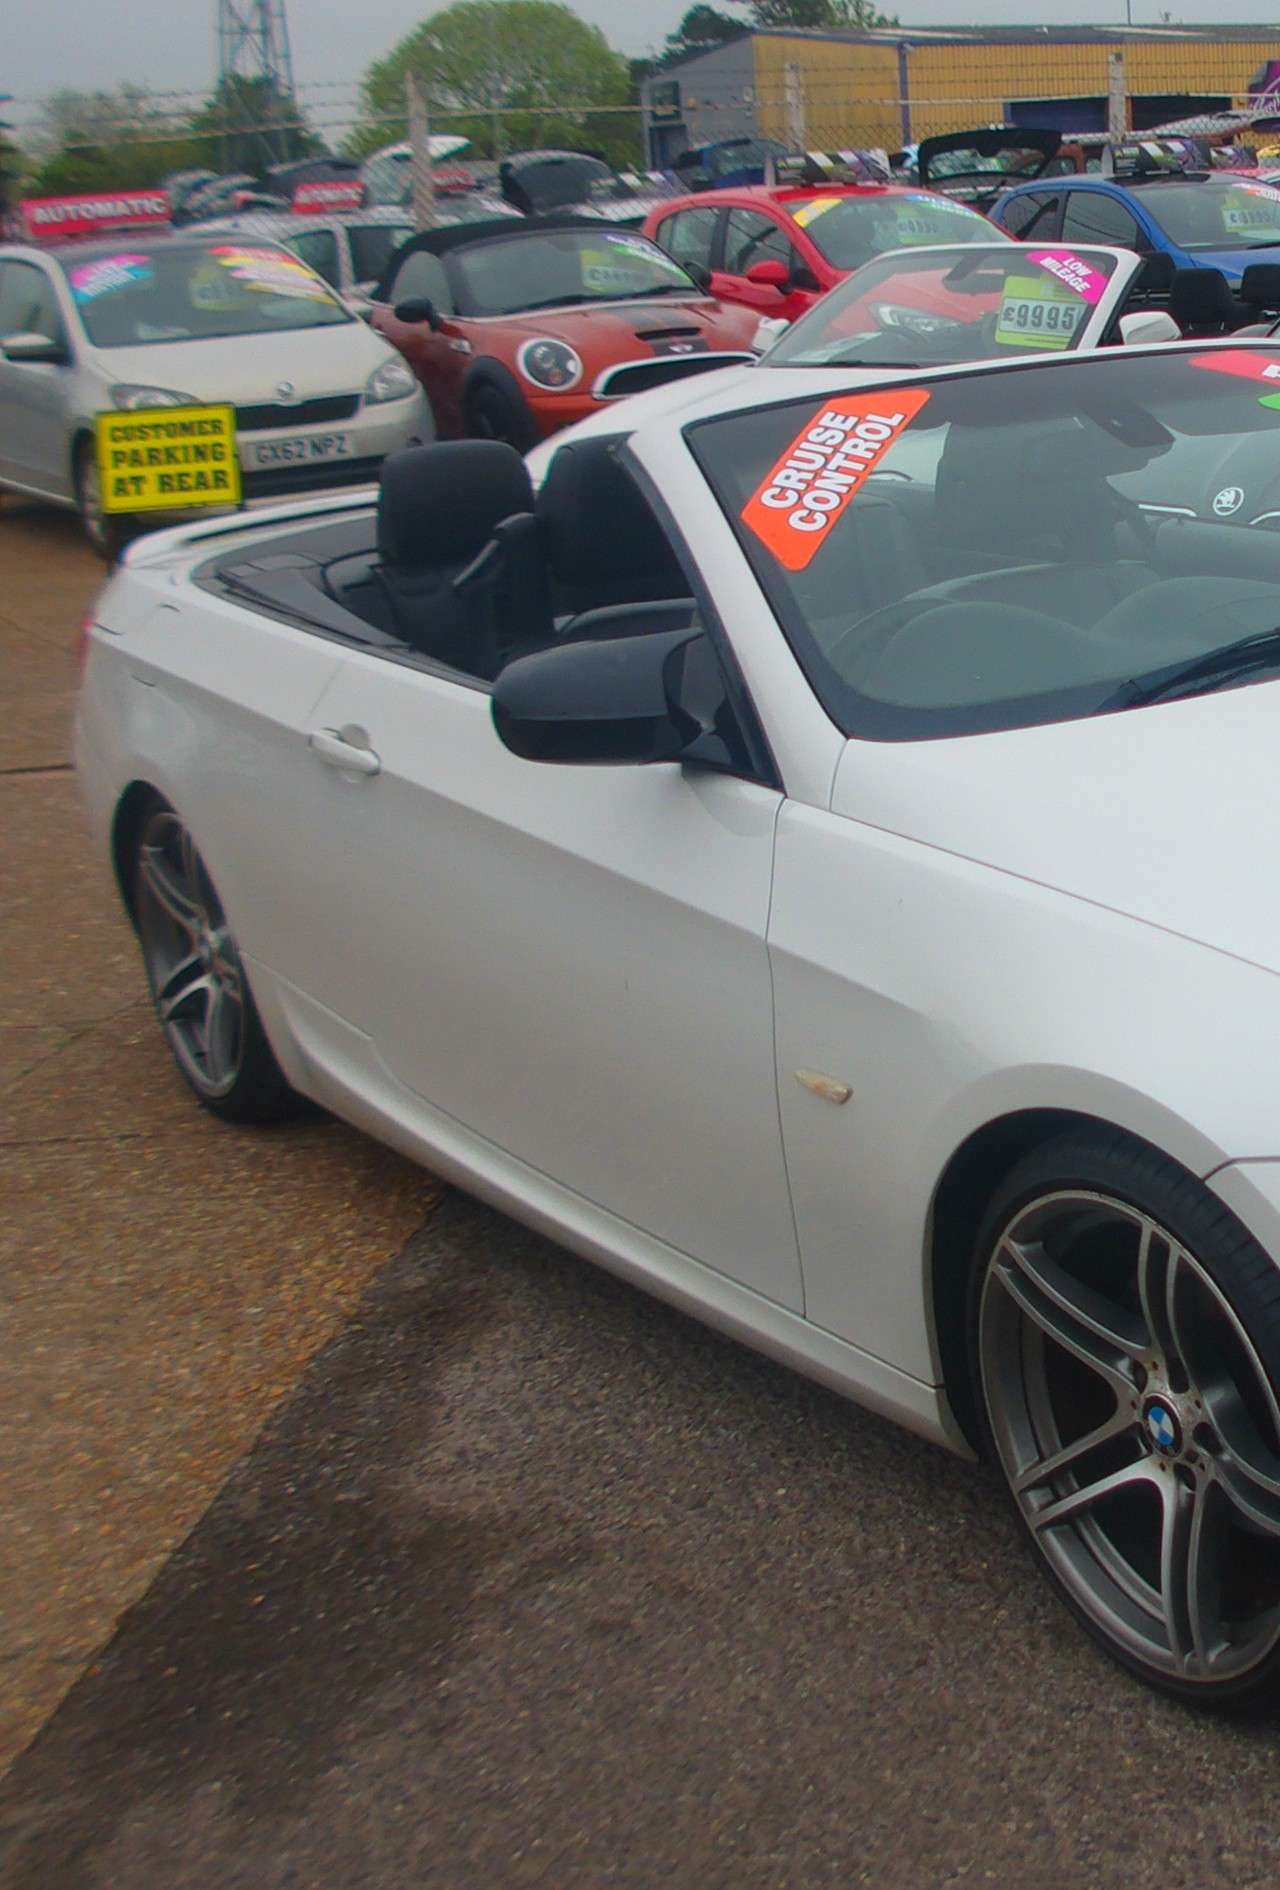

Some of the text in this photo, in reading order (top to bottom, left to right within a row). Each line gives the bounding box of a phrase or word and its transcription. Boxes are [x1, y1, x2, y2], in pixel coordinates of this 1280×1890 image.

[34, 198, 166, 225] AUTOMATIC
[1040, 256, 1092, 293] MILEAGE
[1062, 257, 1094, 276] LOW
[1003, 304, 1076, 330] £9995
[109, 419, 224, 442] CUSTOMER
[111, 443, 225, 469] PARKING
[761, 411, 859, 509] CRUISE
[113, 470, 229, 496] AT REAR
[788, 413, 905, 532] CONTROL
